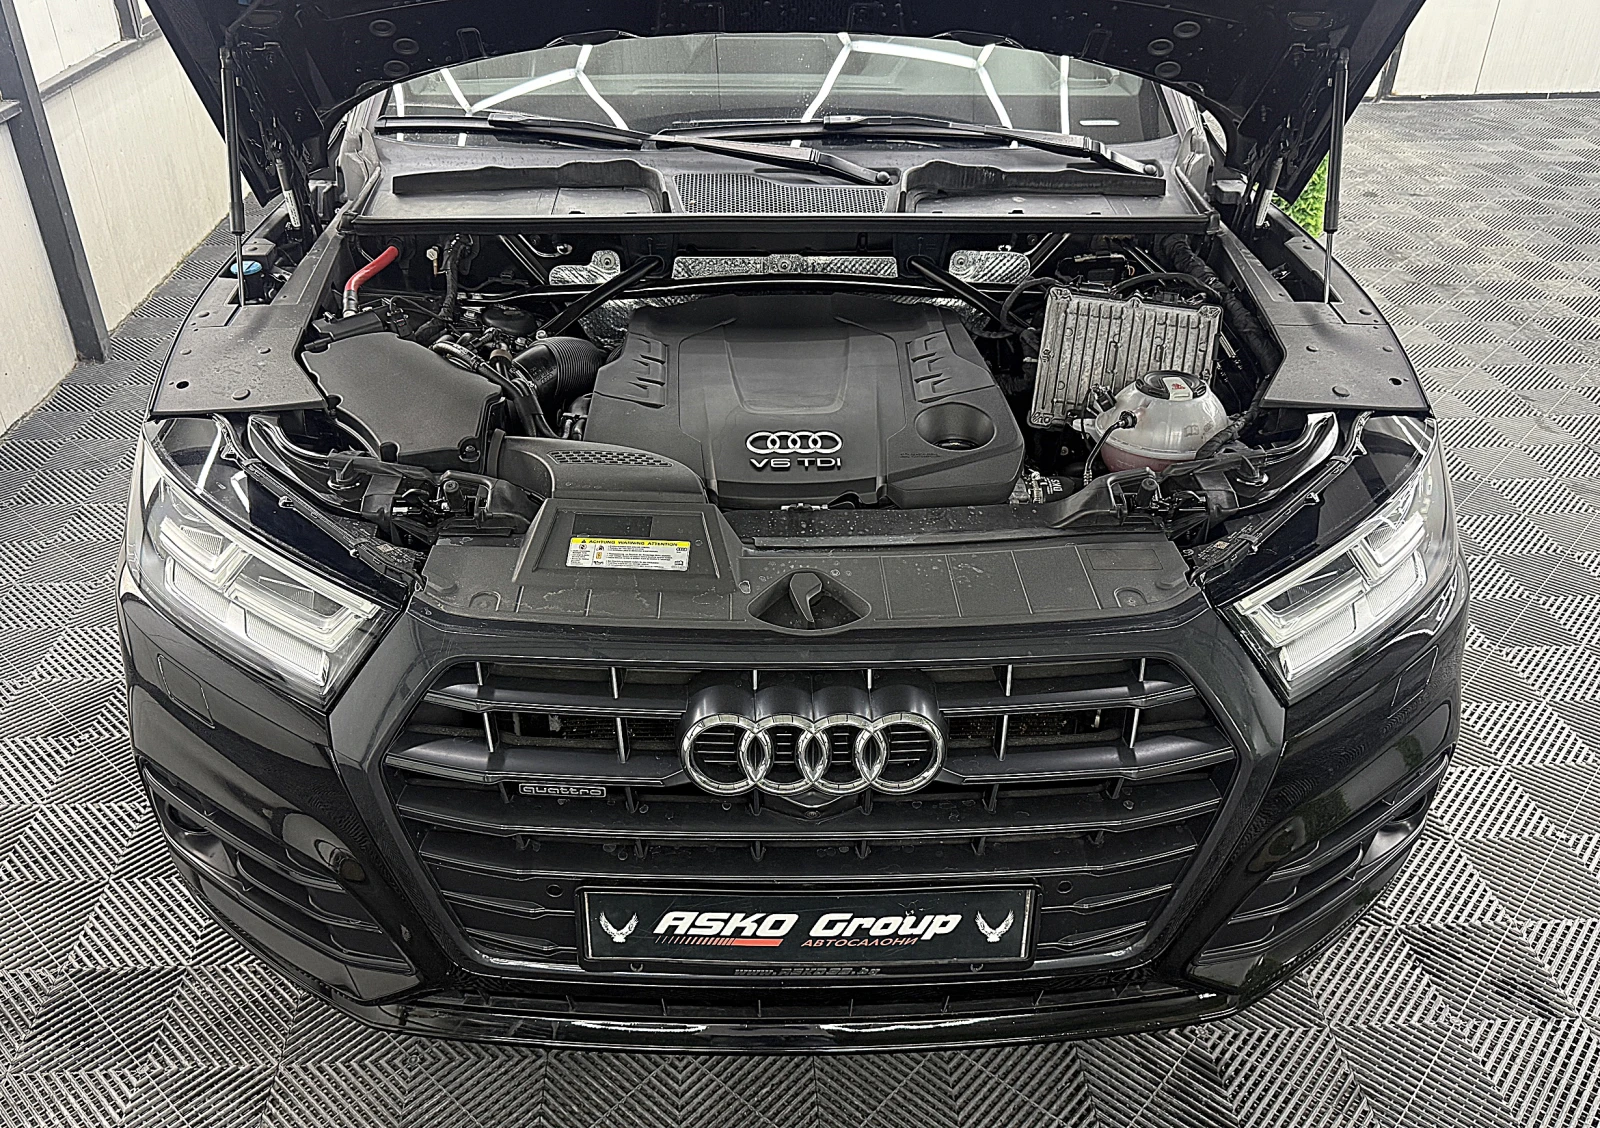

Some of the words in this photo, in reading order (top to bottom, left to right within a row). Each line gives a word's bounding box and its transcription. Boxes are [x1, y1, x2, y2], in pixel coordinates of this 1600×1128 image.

[750, 458, 791, 468] V6
[797, 458, 842, 468] TDI
[523, 786, 602, 796] quattro
[653, 911, 799, 936] ASKO
[809, 912, 963, 940] Group
[800, 937, 920, 948] АВТОСАЛОНИ
